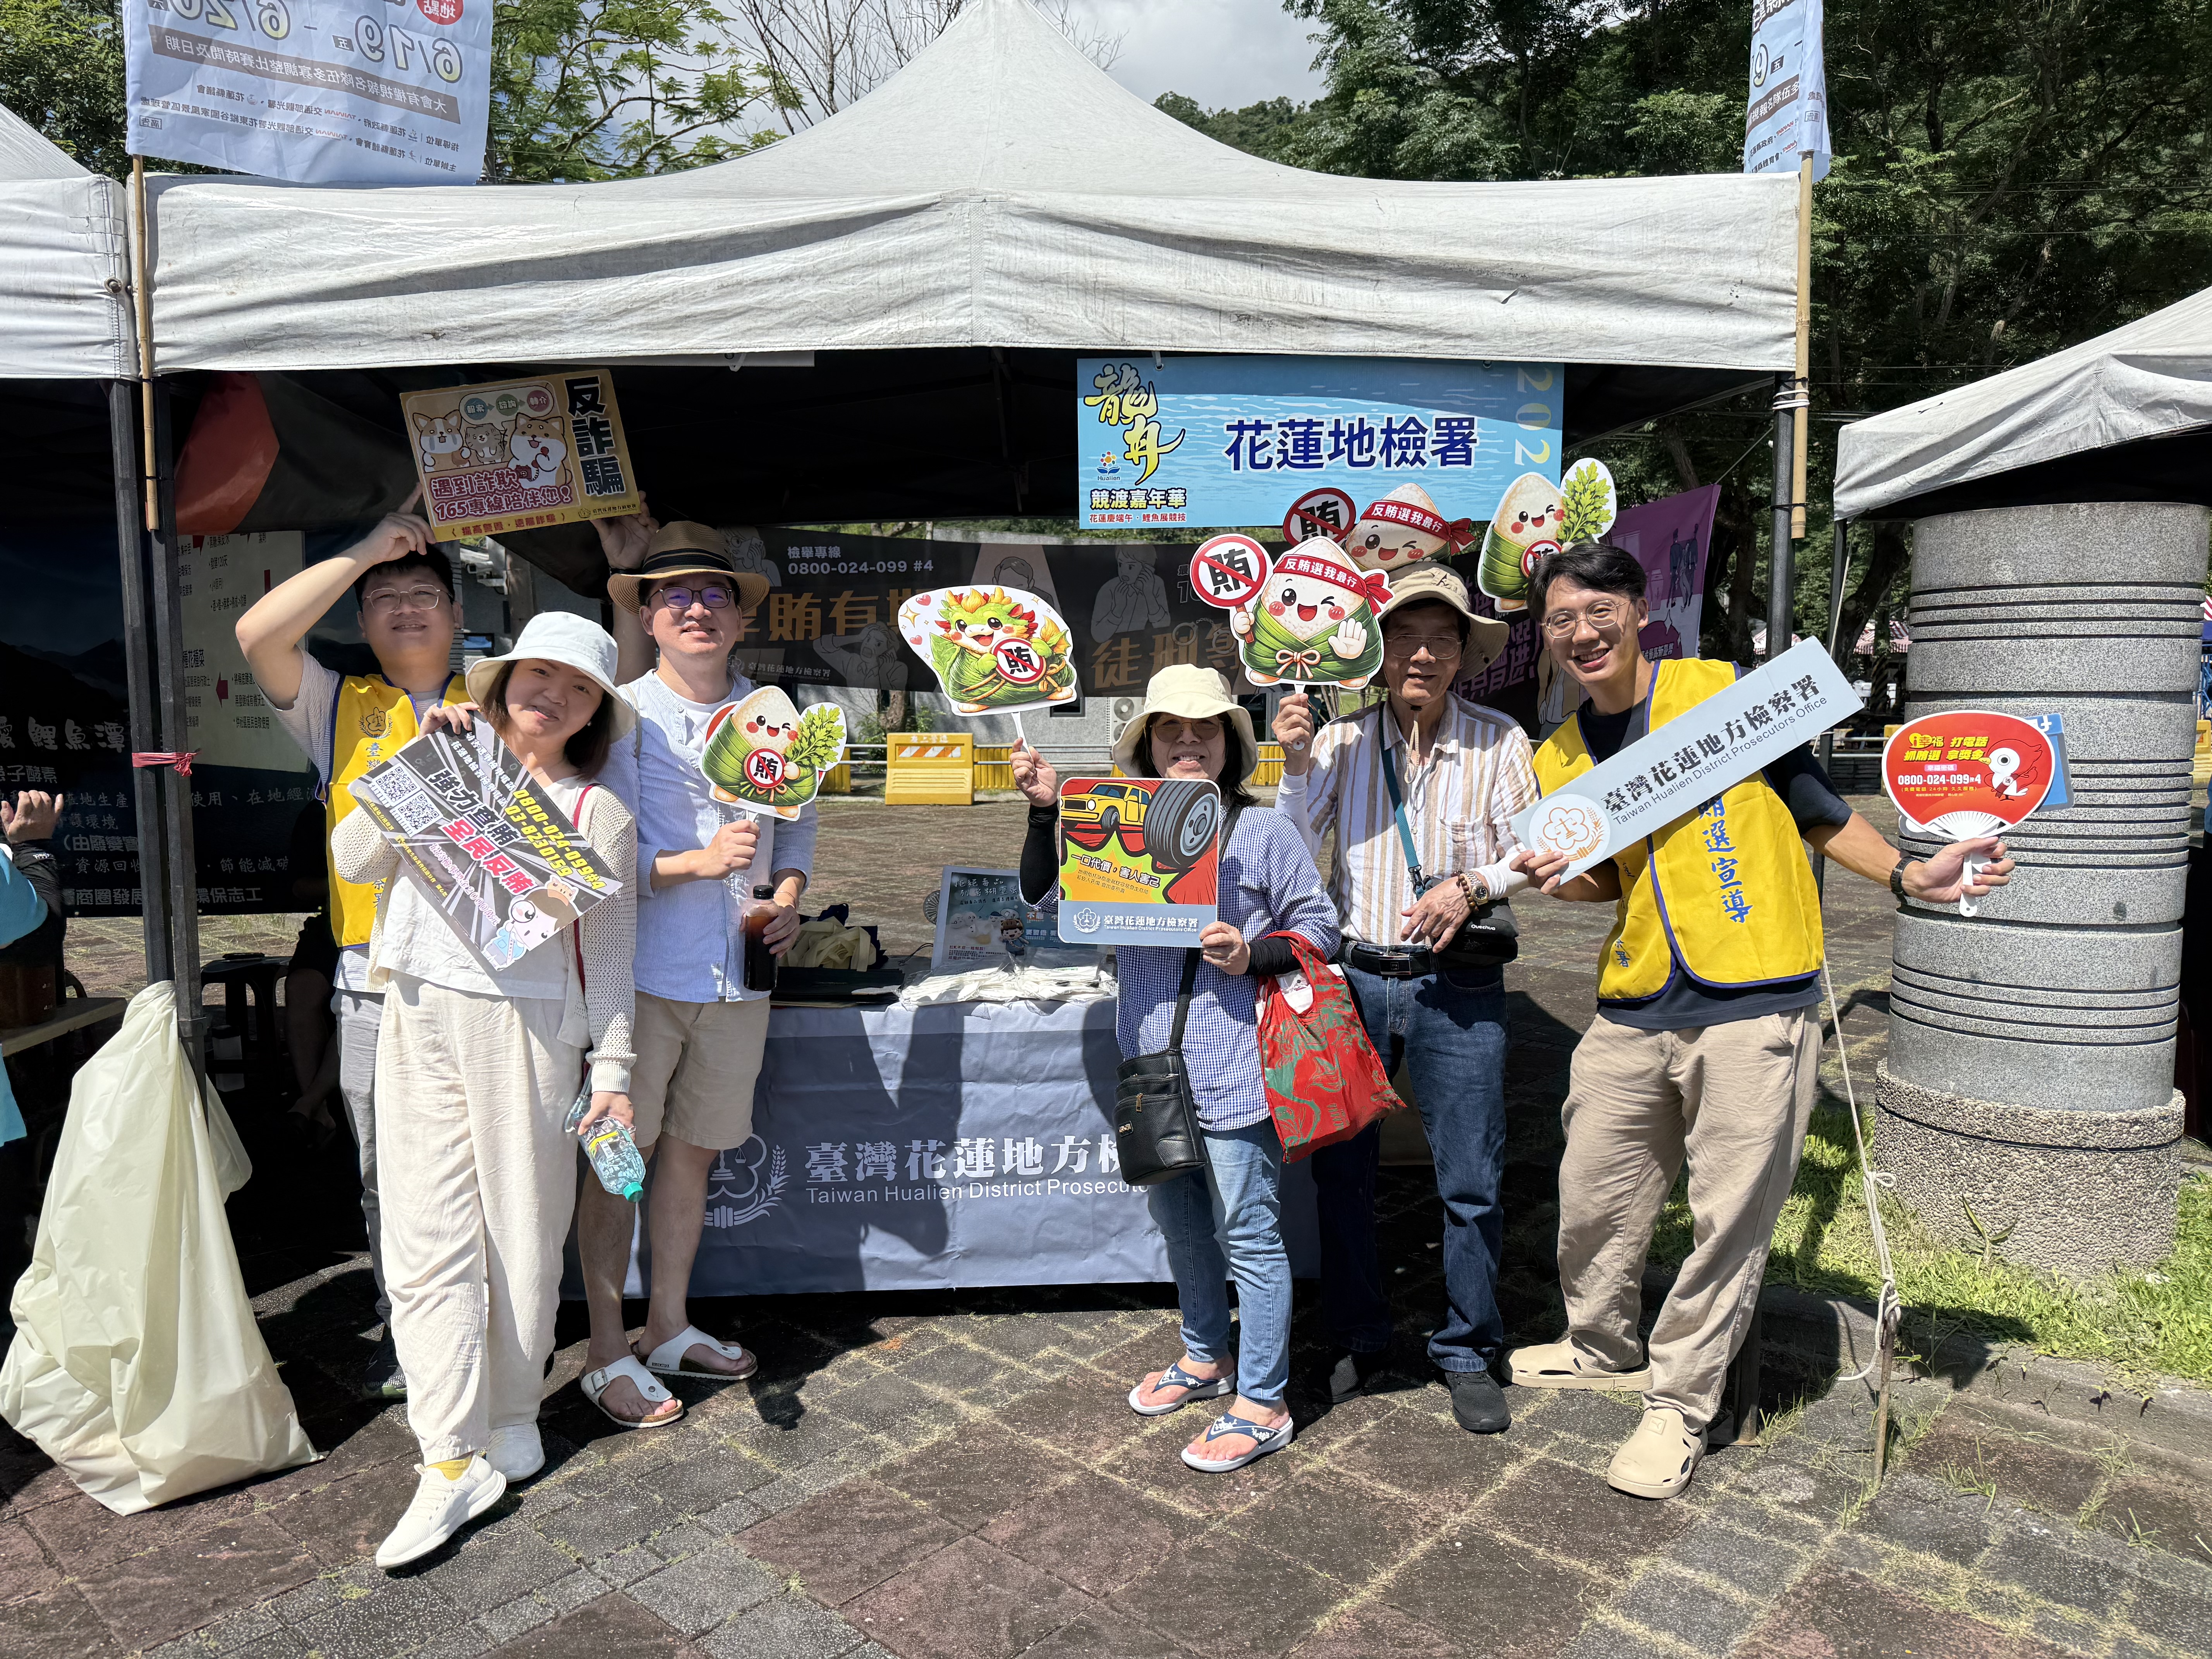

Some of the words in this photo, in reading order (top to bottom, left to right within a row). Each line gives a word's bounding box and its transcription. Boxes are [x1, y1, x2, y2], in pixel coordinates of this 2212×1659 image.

[1751, 43, 1769, 88] 9
[564, 375, 626, 497] 反詐騙
[1224, 416, 1477, 471] 花蓮地檢署
[430, 467, 520, 500] 遇到詐欺
[1090, 488, 1187, 510] 競渡嘉年華
[1371, 503, 1443, 533] 反賄選我最行
[787, 546, 842, 560] 檢舉專線
[788, 560, 908, 575] 0800-024-099
[913, 559, 934, 572] #4
[1209, 548, 1253, 596] 賄
[1284, 558, 1357, 588] 反賄選我最行
[1006, 646, 1032, 675] 賄
[1601, 675, 1821, 816] 臺灣花蓮地方檢察署
[1903, 749, 1942, 762] 抓賄選
[1949, 736, 1989, 748] 打電話
[753, 756, 778, 780] 賄
[1613, 797, 1652, 826] Taiwan
[1651, 775, 1693, 804] Hualien
[1692, 752, 1733, 780] District
[1729, 714, 1796, 758] Prosecutors
[1795, 696, 1828, 718] Office
[425, 768, 524, 848] 強力查賄
[504, 805, 572, 878] 03-8230159
[513, 789, 607, 891] 0800-024-099#4
[439, 819, 540, 895] 全民反賄
[1104, 915, 1199, 928] 臺灣花蓮地方檢察署
[806, 1186, 878, 1204] Taiwan
[885, 1183, 963, 1202] Hualien
[969, 1180, 1042, 1199] District
